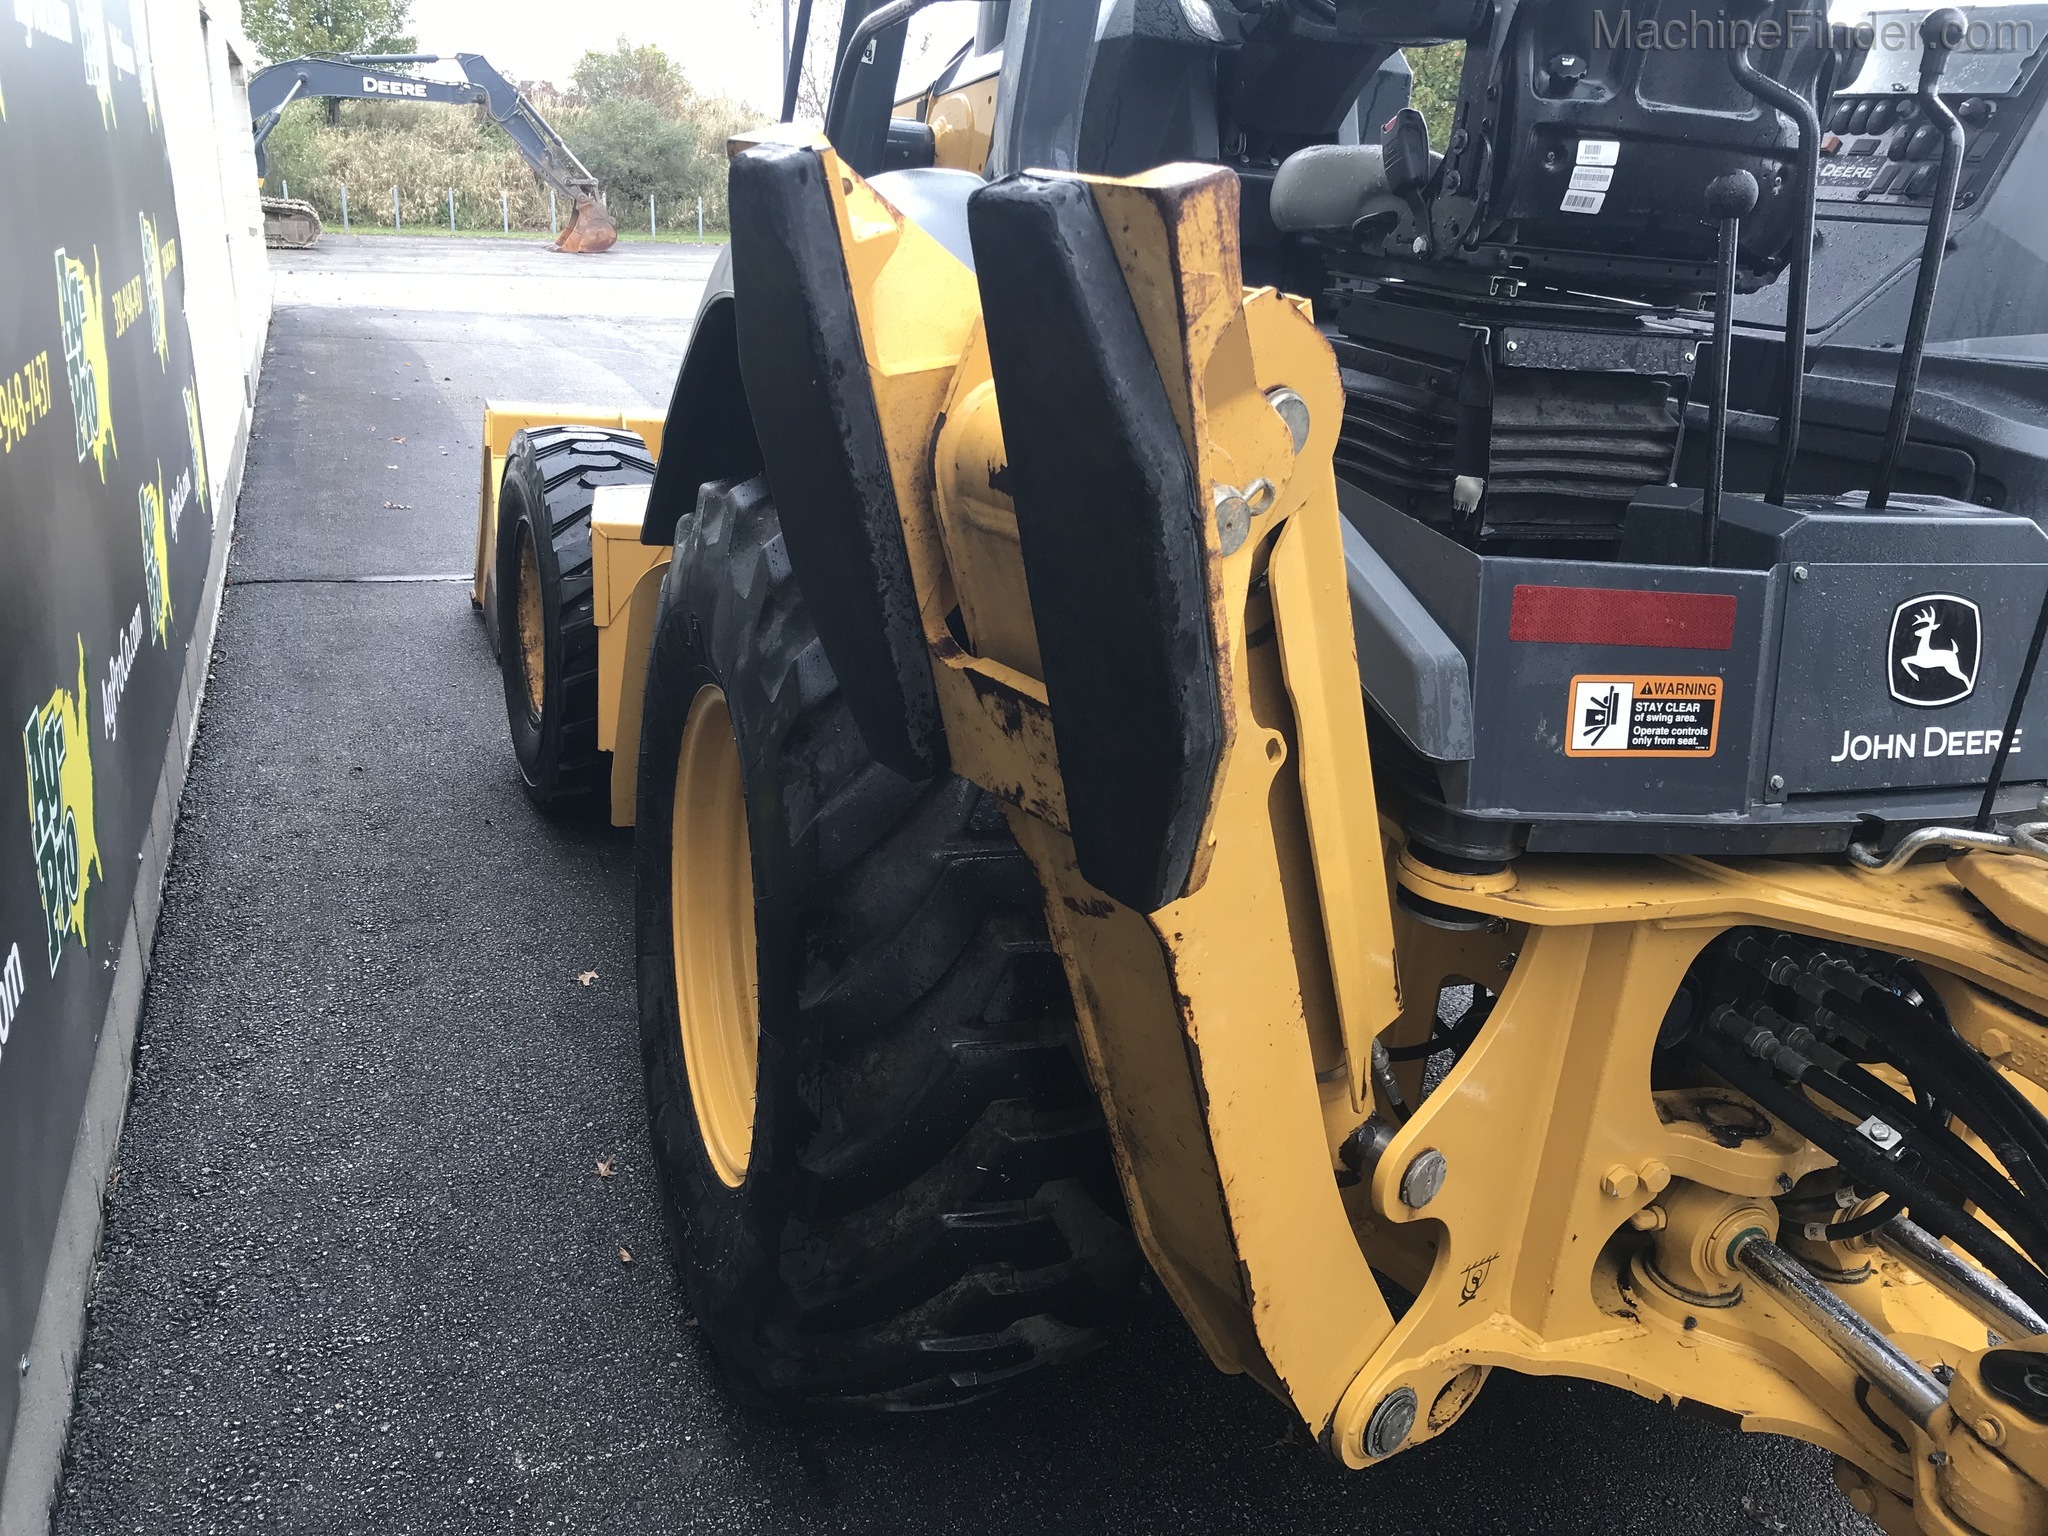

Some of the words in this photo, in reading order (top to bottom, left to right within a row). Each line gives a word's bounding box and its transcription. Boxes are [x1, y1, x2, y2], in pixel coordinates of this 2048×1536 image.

[362, 76, 428, 98] DEERE
[1820, 163, 1878, 179] DEERE
[101, 603, 143, 742] AgProCo.com
[1654, 682, 1717, 696] WARNING
[1635, 702, 1663, 712] STAY
[1665, 702, 1700, 713] CLEAR
[1634, 712, 1645, 722] of
[1646, 713, 1673, 724] swing
[1675, 715, 1697, 723] area.
[1633, 725, 1670, 737] Operate
[1671, 726, 1709, 736] controls
[1632, 736, 1652, 747] only
[1654, 736, 1675, 745] from
[1677, 736, 1699, 746] seat.
[1830, 730, 1917, 763] JOHN
[1923, 726, 2023, 758] DEERE
[37, 810, 80, 979] Pro
